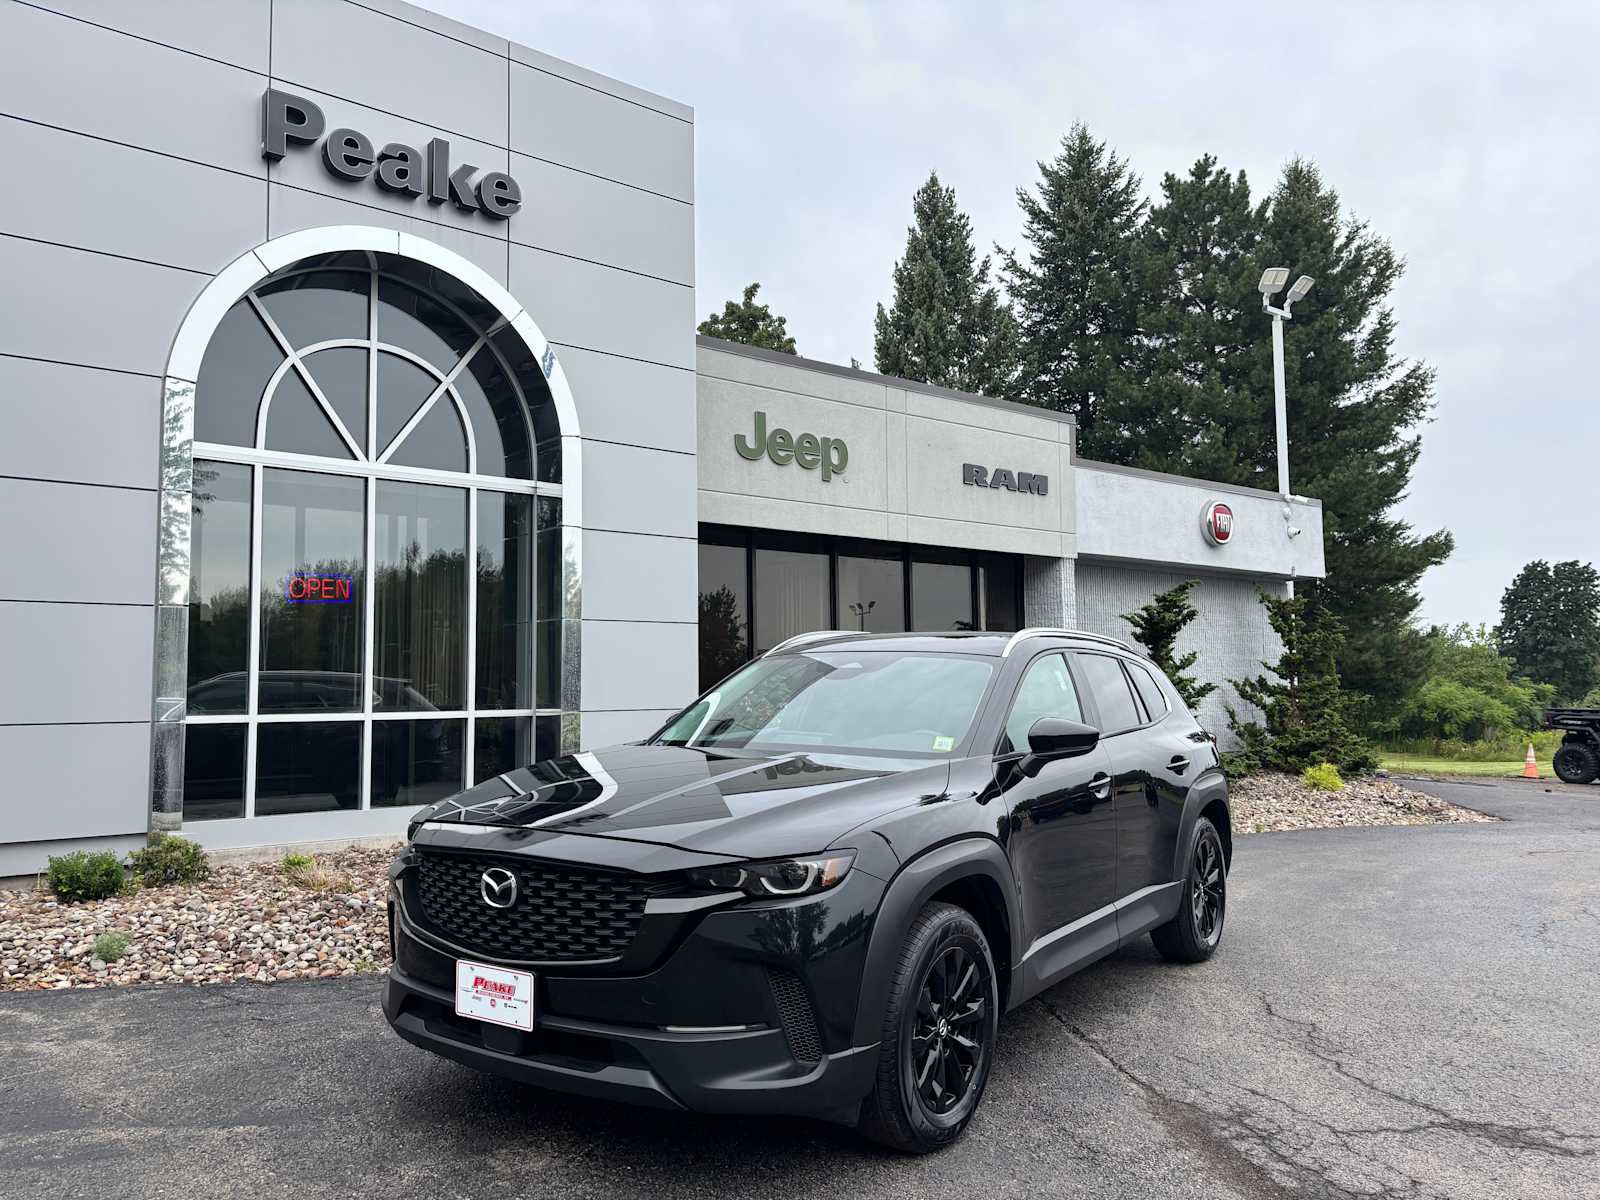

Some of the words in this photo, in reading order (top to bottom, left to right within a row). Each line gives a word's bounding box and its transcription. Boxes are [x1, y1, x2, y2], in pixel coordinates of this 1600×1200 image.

[261, 88, 521, 219] Peake
[734, 411, 849, 482] Jeep
[963, 463, 1049, 496] RAM
[289, 577, 350, 600] OPEN
[473, 976, 516, 997] PEAKE
